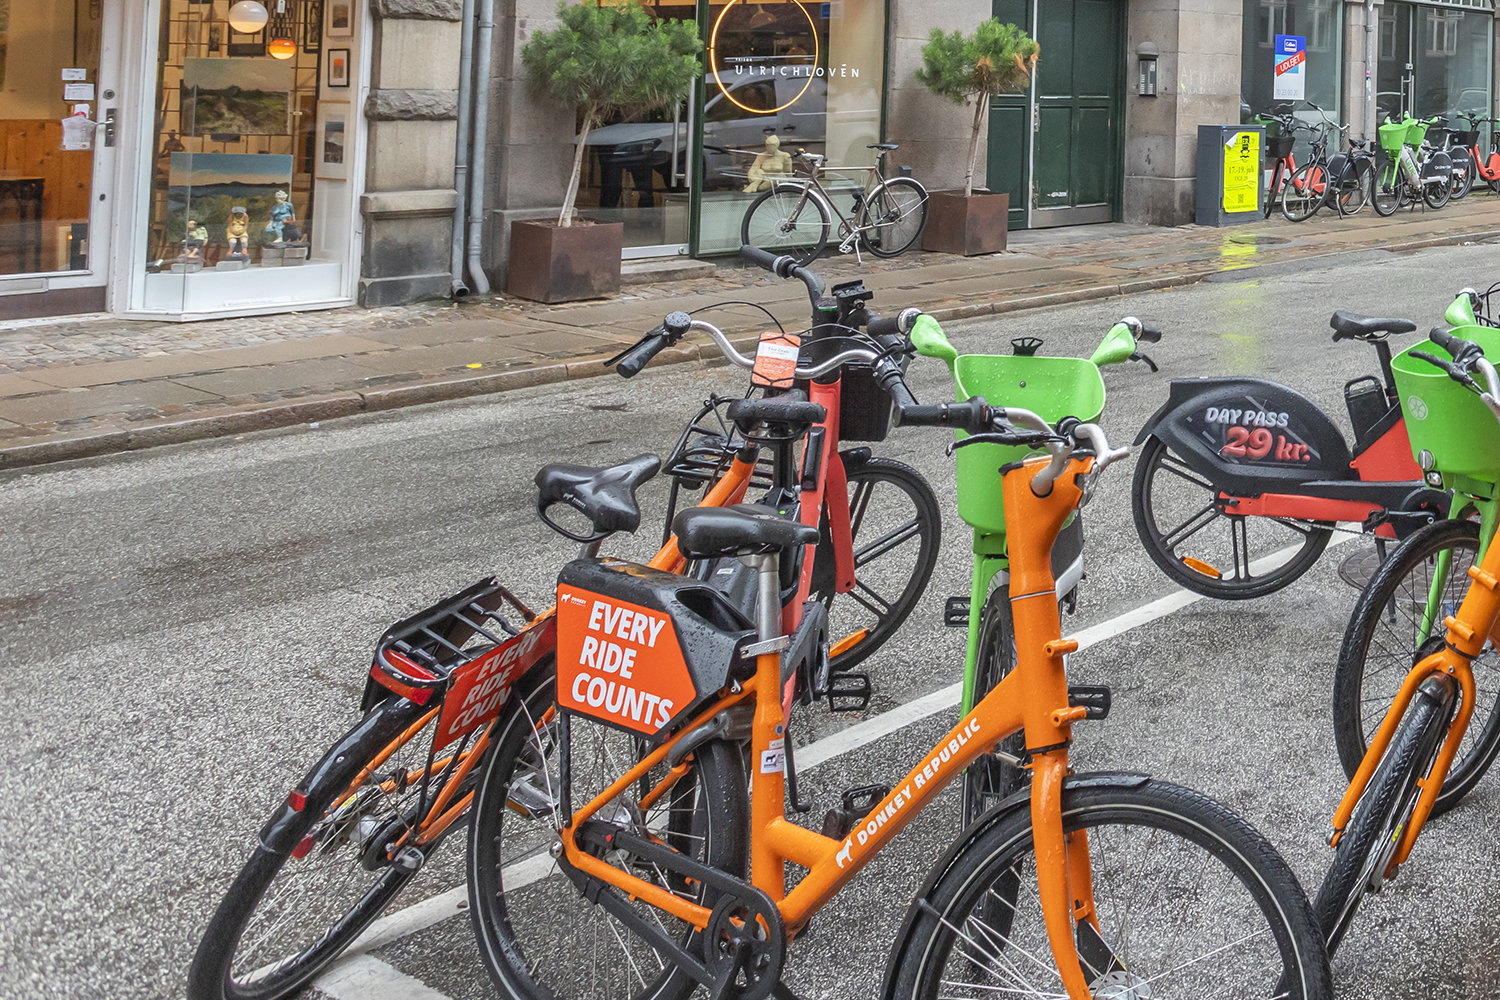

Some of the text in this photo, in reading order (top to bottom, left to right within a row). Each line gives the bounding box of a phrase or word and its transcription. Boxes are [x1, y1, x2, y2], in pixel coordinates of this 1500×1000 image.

[1280, 54, 1301, 72] UDLEJET
[1205, 407, 1290, 429] DAY PASS
[1222, 426, 1312, 462] 29 kr.
[588, 600, 666, 648] EVERY
[476, 629, 545, 682] EVERY
[579, 635, 638, 680] RIDE
[461, 663, 514, 710] RIDE
[571, 672, 675, 730] COUNTS
[857, 717, 981, 845] DONKEY REPUBLIC
